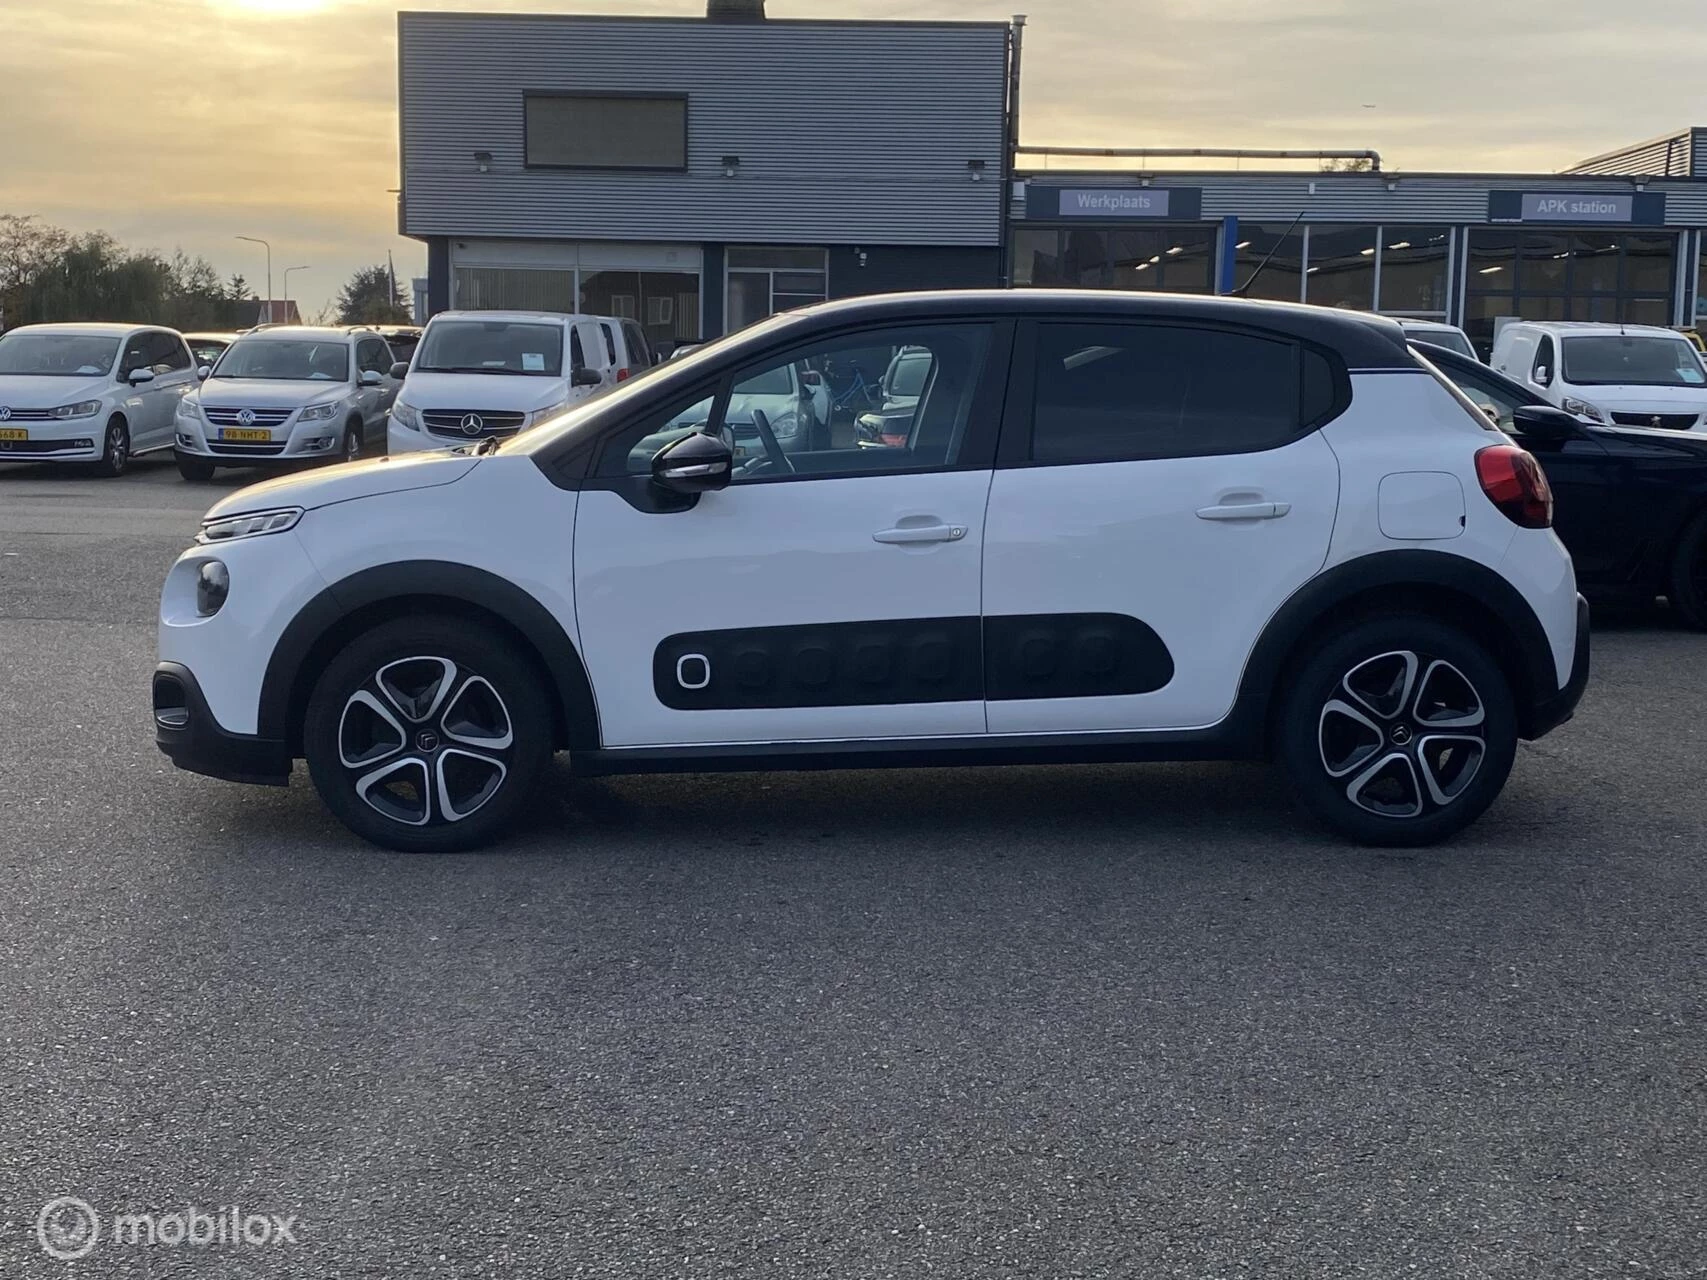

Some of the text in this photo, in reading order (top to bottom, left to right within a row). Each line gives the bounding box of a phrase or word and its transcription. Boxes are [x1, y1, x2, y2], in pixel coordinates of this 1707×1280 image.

[1077, 194, 1151, 211] Werkplaats
[1537, 199, 1616, 214] APK station
